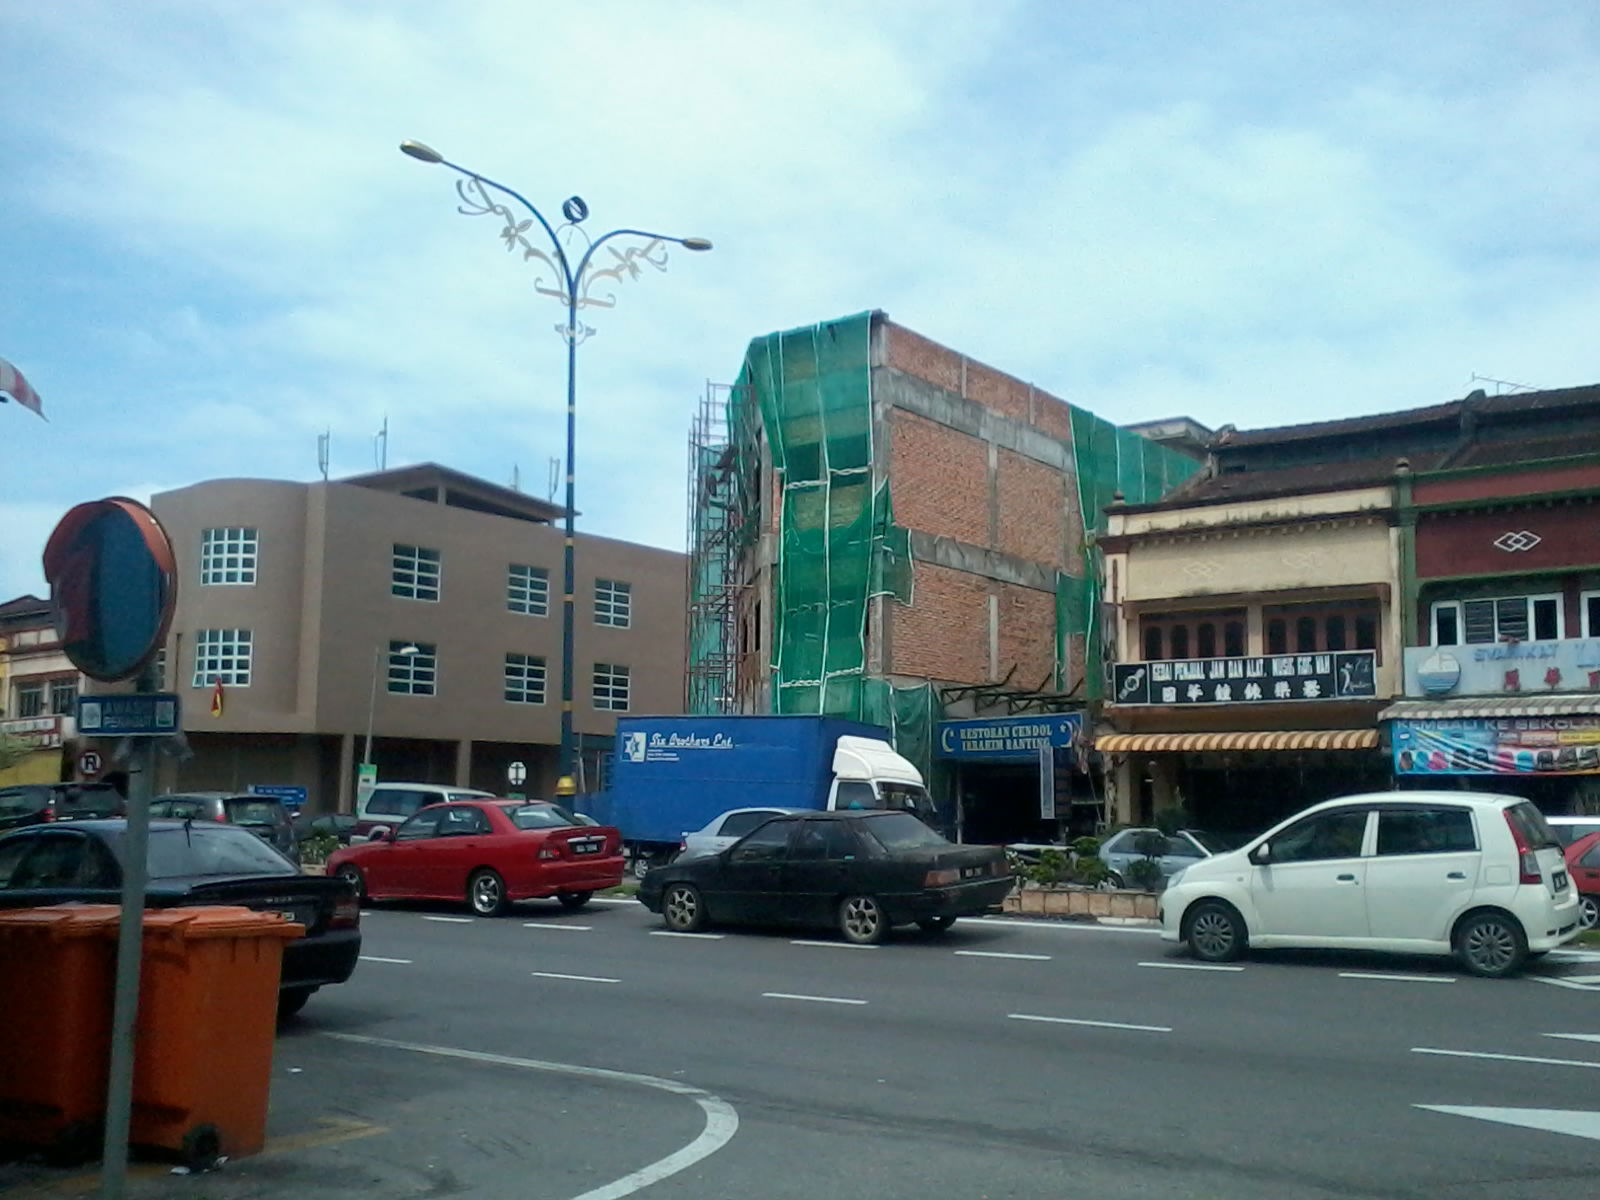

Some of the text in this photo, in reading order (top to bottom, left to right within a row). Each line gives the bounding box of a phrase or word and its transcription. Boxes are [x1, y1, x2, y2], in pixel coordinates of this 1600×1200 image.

[1485, 719, 1509, 730] KE
[960, 724, 1052, 739] RESTORAN CENDOL
